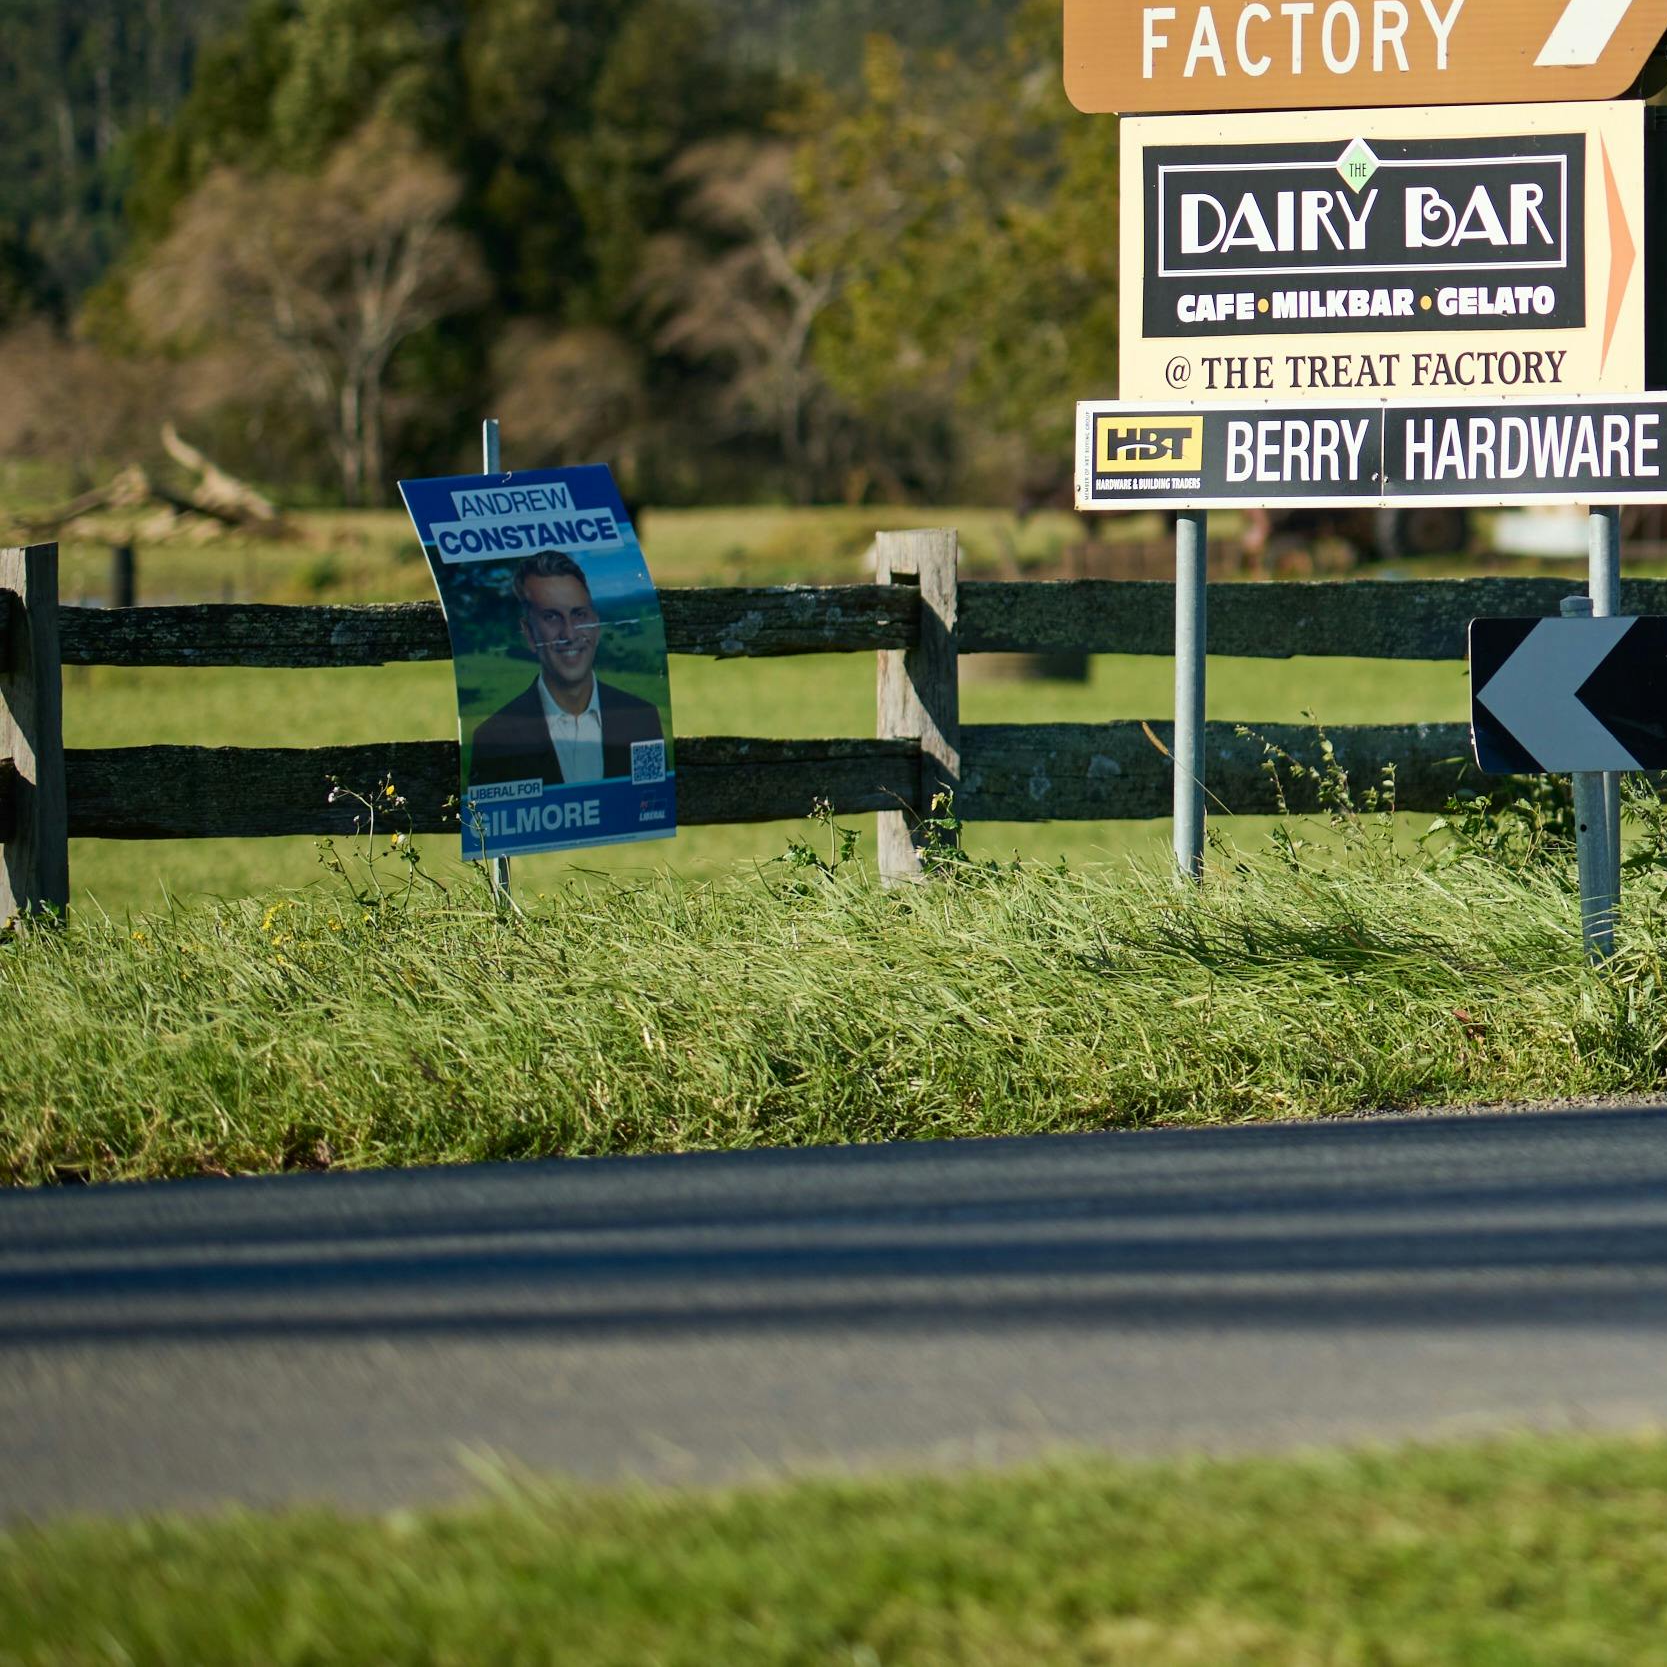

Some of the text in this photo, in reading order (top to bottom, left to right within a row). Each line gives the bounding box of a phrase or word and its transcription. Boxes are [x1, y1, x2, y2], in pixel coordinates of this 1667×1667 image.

[1348, 161, 1368, 179] THE
[1180, 183, 1554, 255] DAIRY BAR
[1176, 285, 1556, 324] CAFE MILKBAR GELATO
[1165, 350, 1568, 390] @ THE TREAT FACTORY
[1106, 427, 1193, 461] HBT
[1225, 413, 1661, 483] BERRY HARDWARE
[461, 486, 568, 519] ANDREW
[1095, 477, 1201, 491] HARDWARE & BUILDING TRADERS
[438, 517, 619, 556] CONSTANCE
[470, 782, 541, 801] LIBERAL FOR
[470, 800, 601, 839] GILMORE
